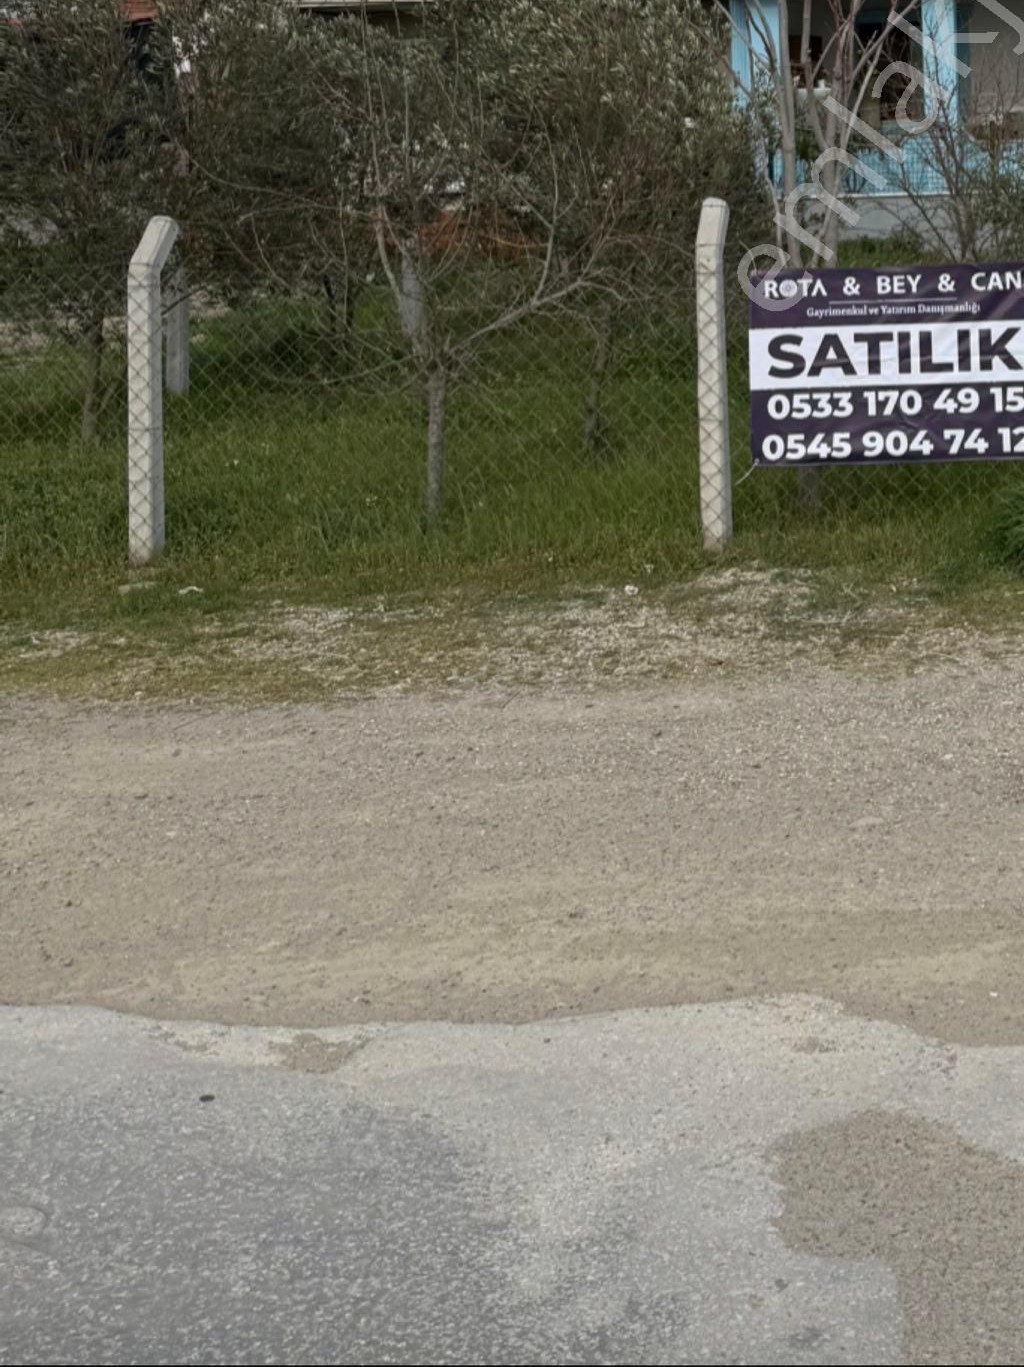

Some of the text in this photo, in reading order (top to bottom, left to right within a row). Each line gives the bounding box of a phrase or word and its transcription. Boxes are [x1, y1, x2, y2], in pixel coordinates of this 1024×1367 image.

[764, 271, 1022, 298] ROTA & BEY & CAN
[806, 304, 867, 318] Gayrimenkul
[868, 306, 879, 315] ve
[767, 327, 1024, 378] SATILIK
[767, 392, 854, 420] 0533
[863, 389, 923, 417] 170
[933, 388, 980, 414] 49
[762, 433, 852, 461] 0545
[862, 430, 934, 457] 904
[943, 428, 989, 455] 74
